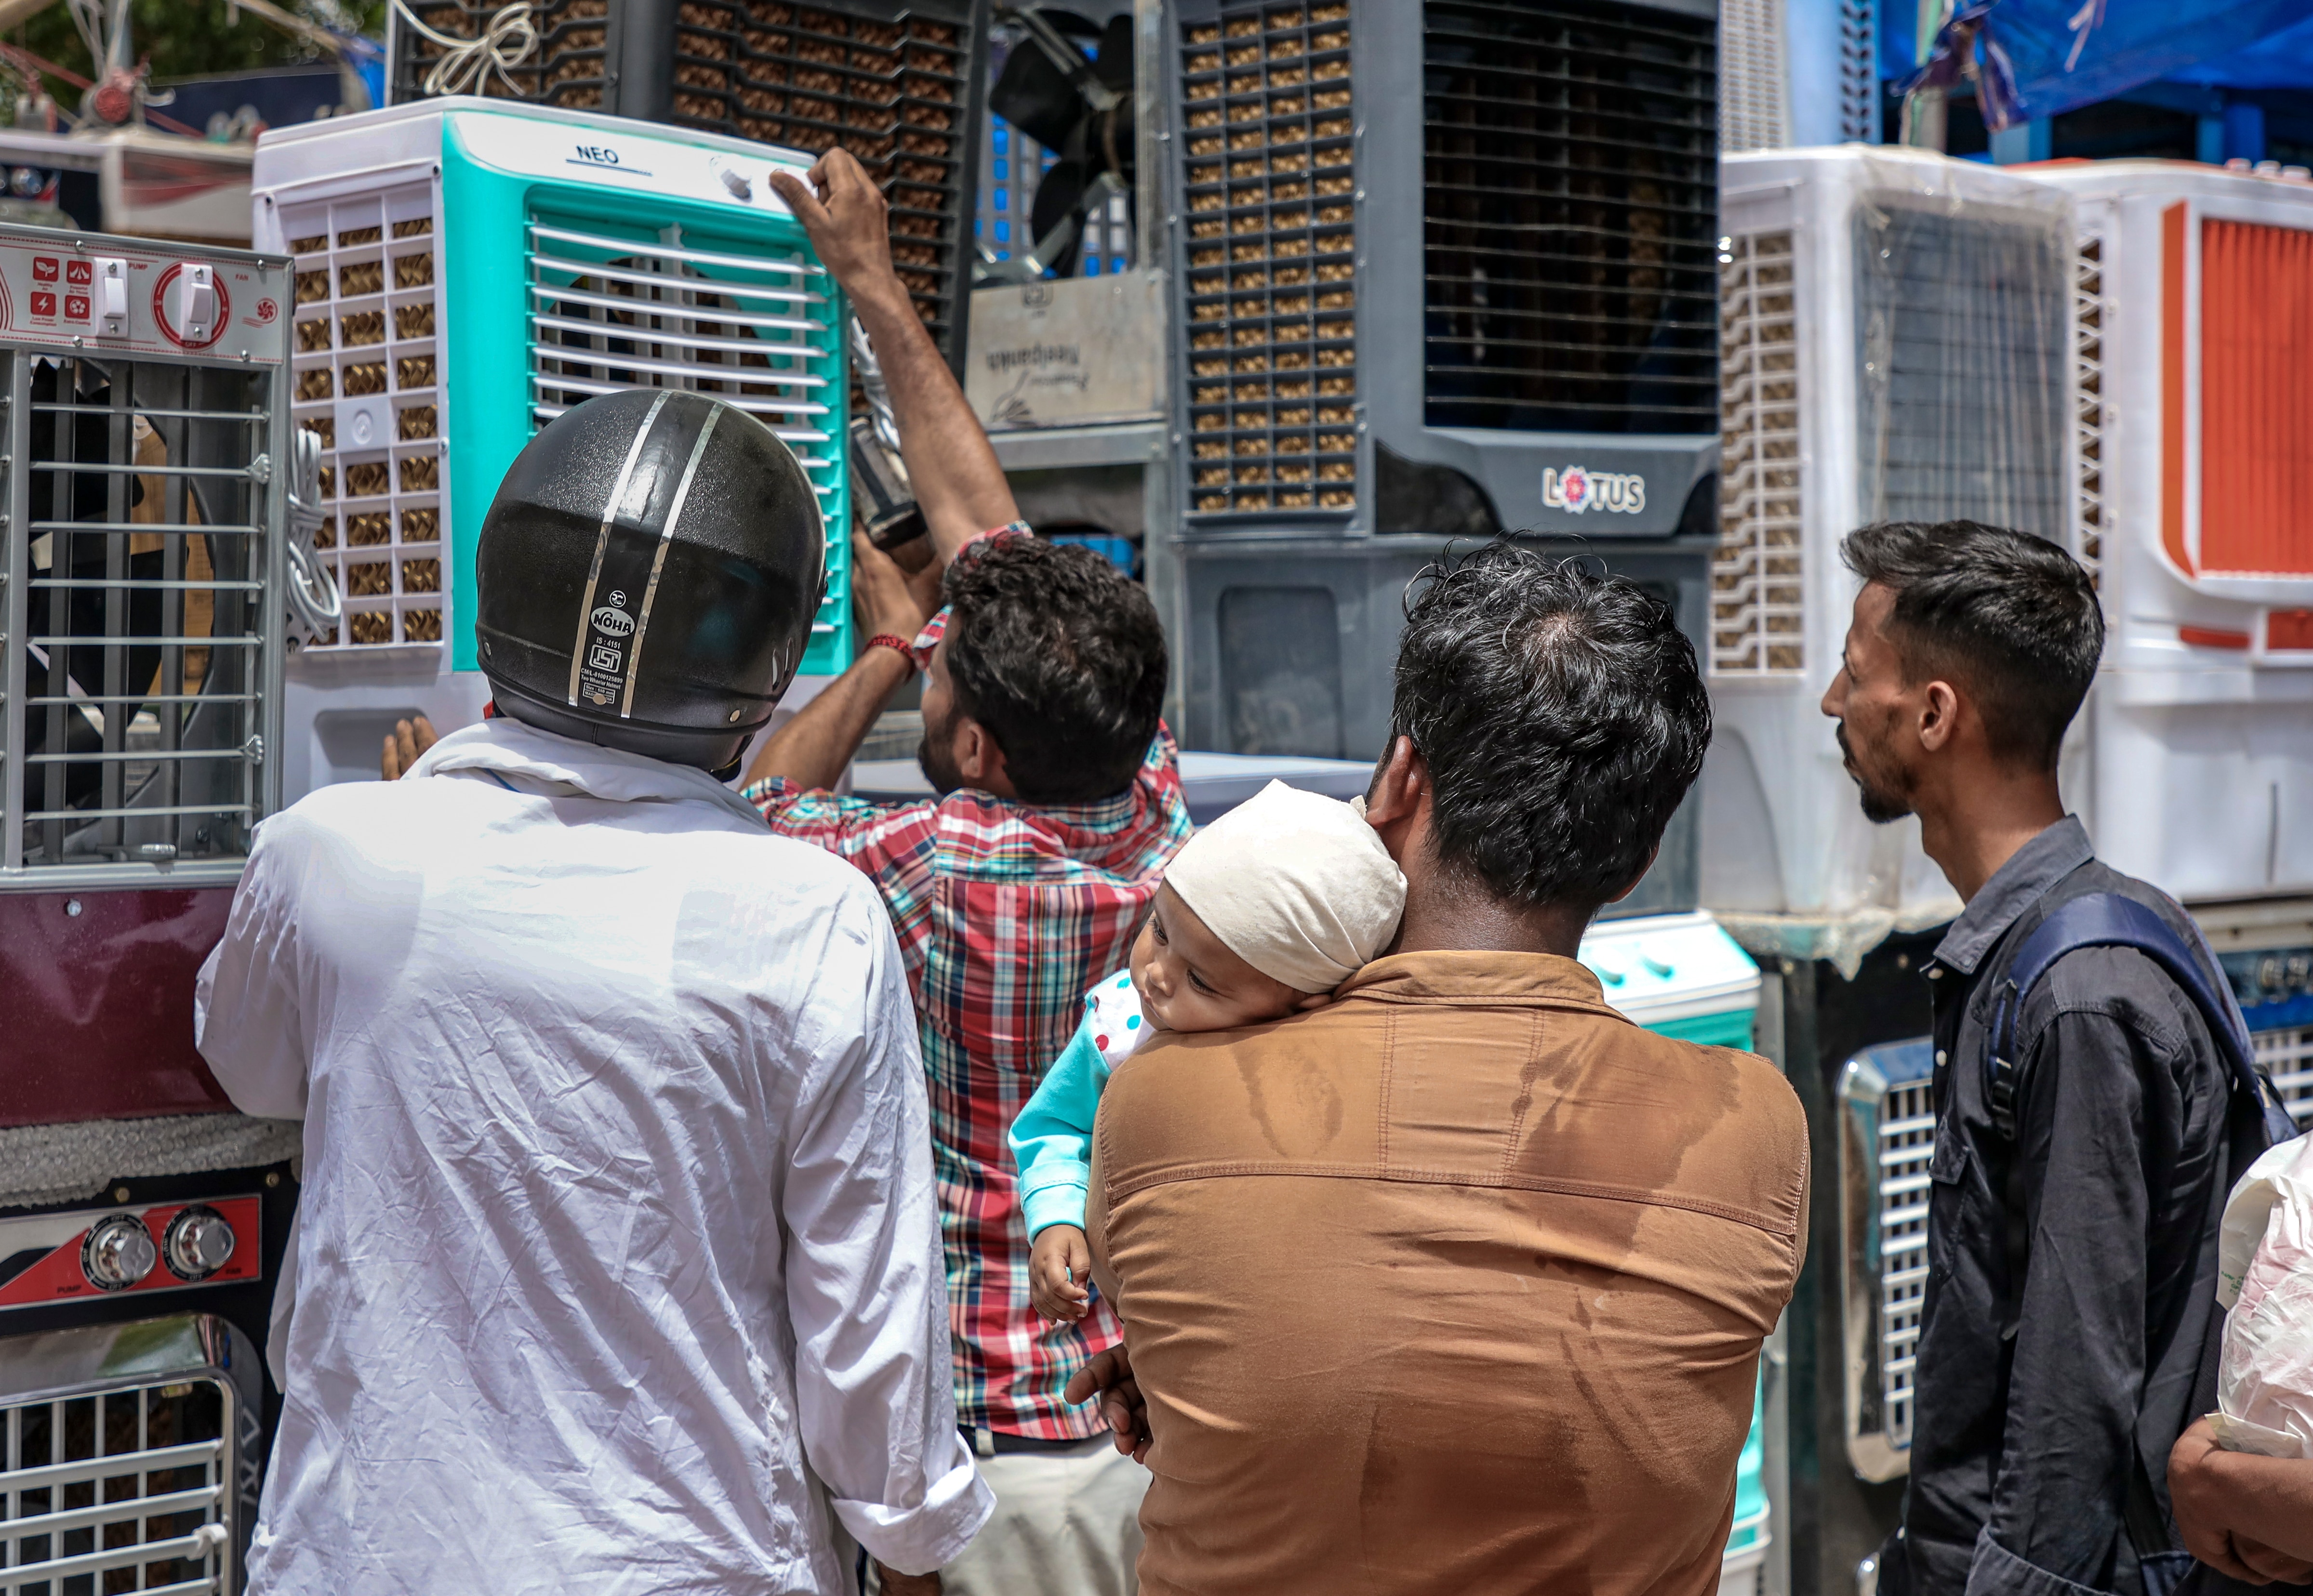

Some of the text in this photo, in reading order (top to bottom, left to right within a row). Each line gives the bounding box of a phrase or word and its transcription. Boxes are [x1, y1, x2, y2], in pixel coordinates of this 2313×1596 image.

[576, 145, 619, 164] NEO
[1542, 465, 1646, 514] LOTUS
[593, 611, 631, 633] NOHA
[596, 636, 603, 645] IS
[607, 640, 621, 649] 4151
[581, 668, 623, 684] CM/L-8100125899
[589, 677, 606, 686] Wheeler
[606, 681, 621, 690] Helmet
[57, 1285, 81, 1293] PUMP
